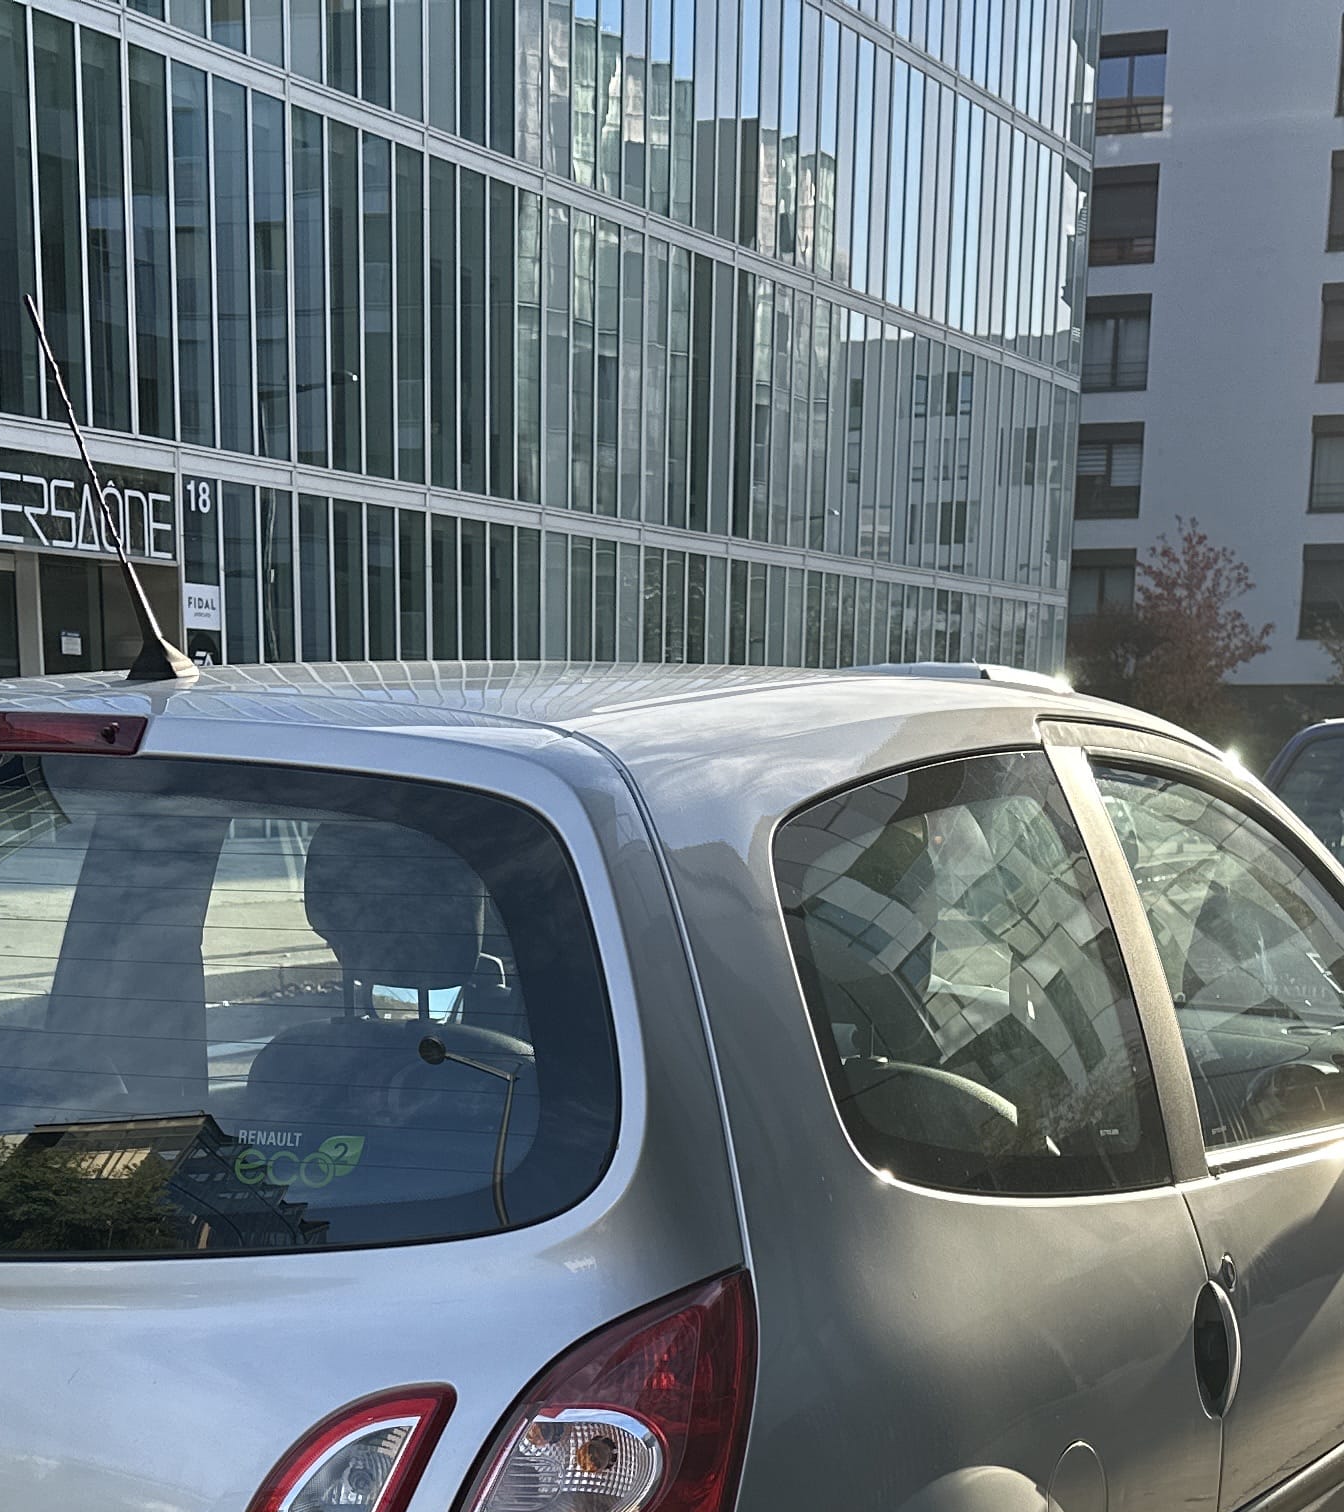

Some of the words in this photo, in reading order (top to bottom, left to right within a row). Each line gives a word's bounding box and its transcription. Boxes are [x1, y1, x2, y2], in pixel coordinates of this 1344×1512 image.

[186, 478, 212, 514] 18
[187, 596, 216, 611] FIDAL
[238, 1129, 303, 1147] RENAULT
